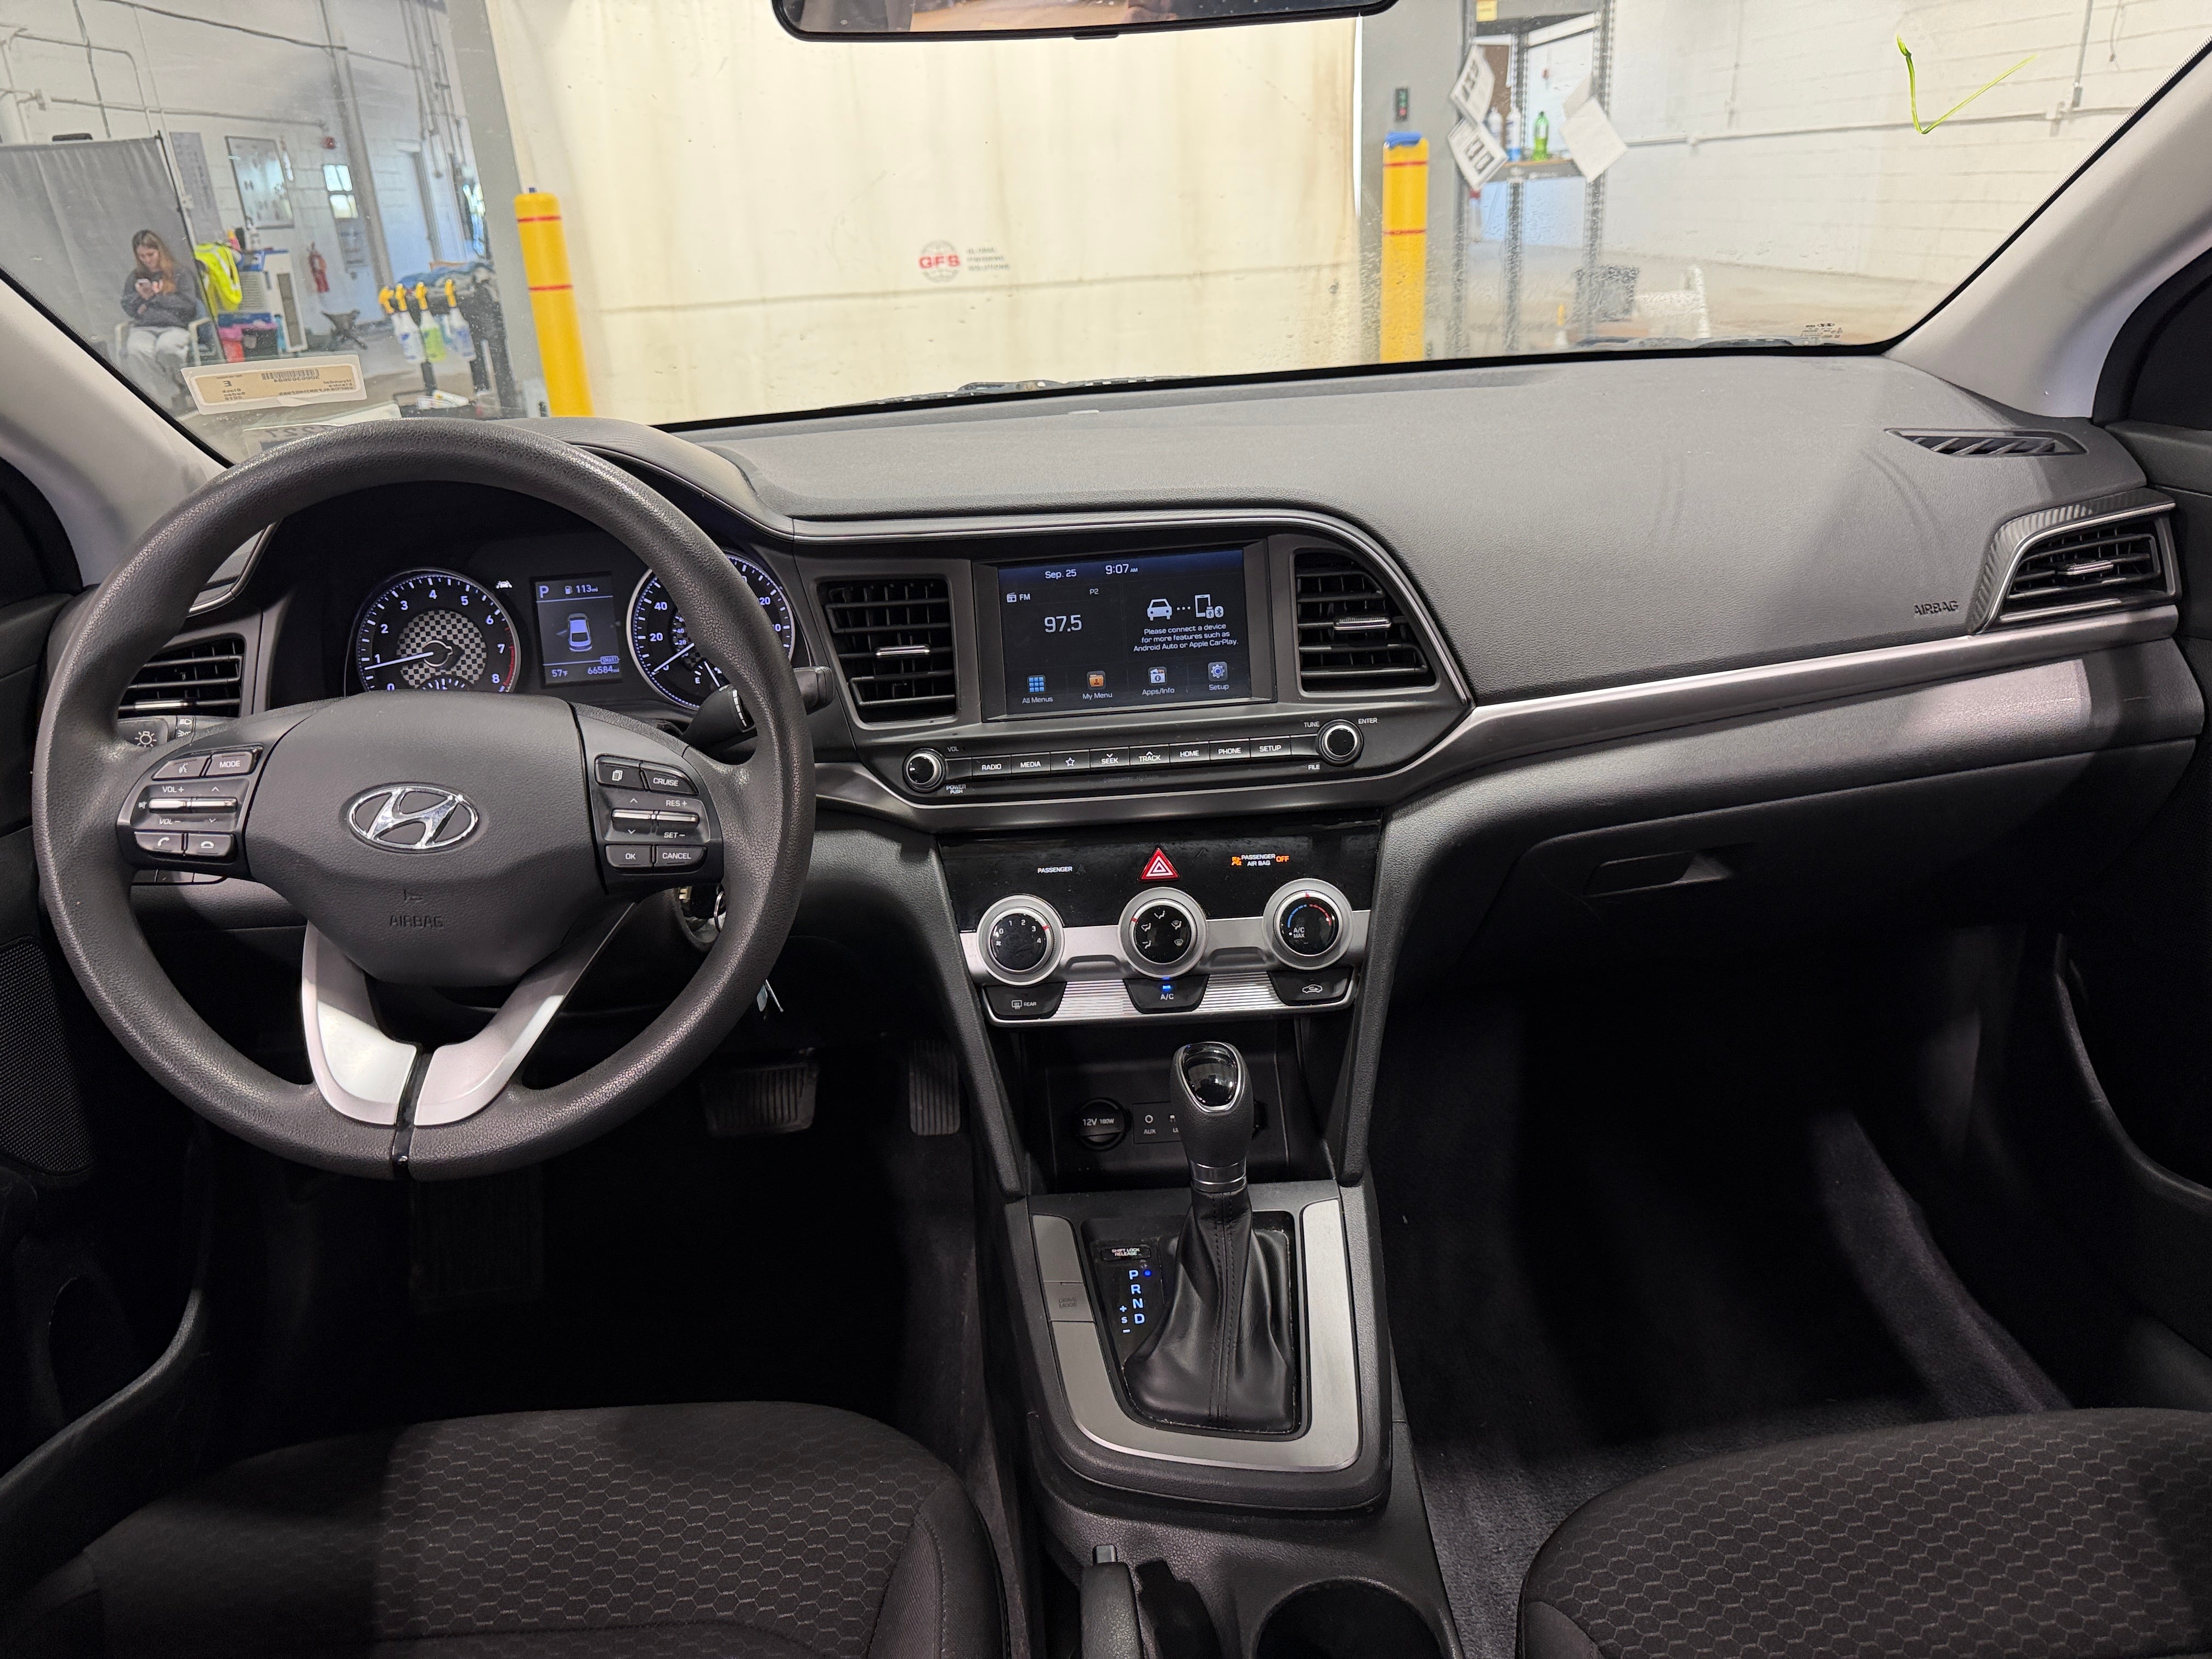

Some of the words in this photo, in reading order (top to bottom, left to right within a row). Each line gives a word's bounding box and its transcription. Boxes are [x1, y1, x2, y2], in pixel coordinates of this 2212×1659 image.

[919, 255, 960, 268] GFS
[1045, 571, 1064, 579] Sep.
[1066, 569, 1077, 577] 25
[1105, 563, 1129, 575] 9:07
[428, 589, 437, 600] 4
[539, 585, 549, 598] P
[1019, 593, 1031, 601] FM
[400, 600, 408, 611] 3
[460, 595, 469, 606] 5
[654, 601, 668, 611] 40
[1914, 600, 1959, 616] AIRBAG
[486, 614, 494, 625] 6
[1044, 614, 1082, 633] 97.5
[380, 623, 388, 634] 2
[650, 632, 663, 642] 20
[496, 643, 505, 653] 7
[1133, 644, 1161, 652] Android
[1209, 638, 1239, 646] CarPlay.
[375, 654, 381, 663] 1
[492, 673, 500, 684] 8
[1082, 693, 1093, 701] My
[1142, 687, 1175, 696] Apps/Info
[219, 760, 241, 768] MODE
[653, 777, 679, 787] CRUISE
[389, 915, 443, 928] AIRBAG
[1082, 1118, 1098, 1126] 12V
[1128, 1269, 1139, 1280] P
[1131, 1284, 1141, 1294] R
[1132, 1298, 1144, 1309] N
[1134, 1313, 1146, 1324] D
